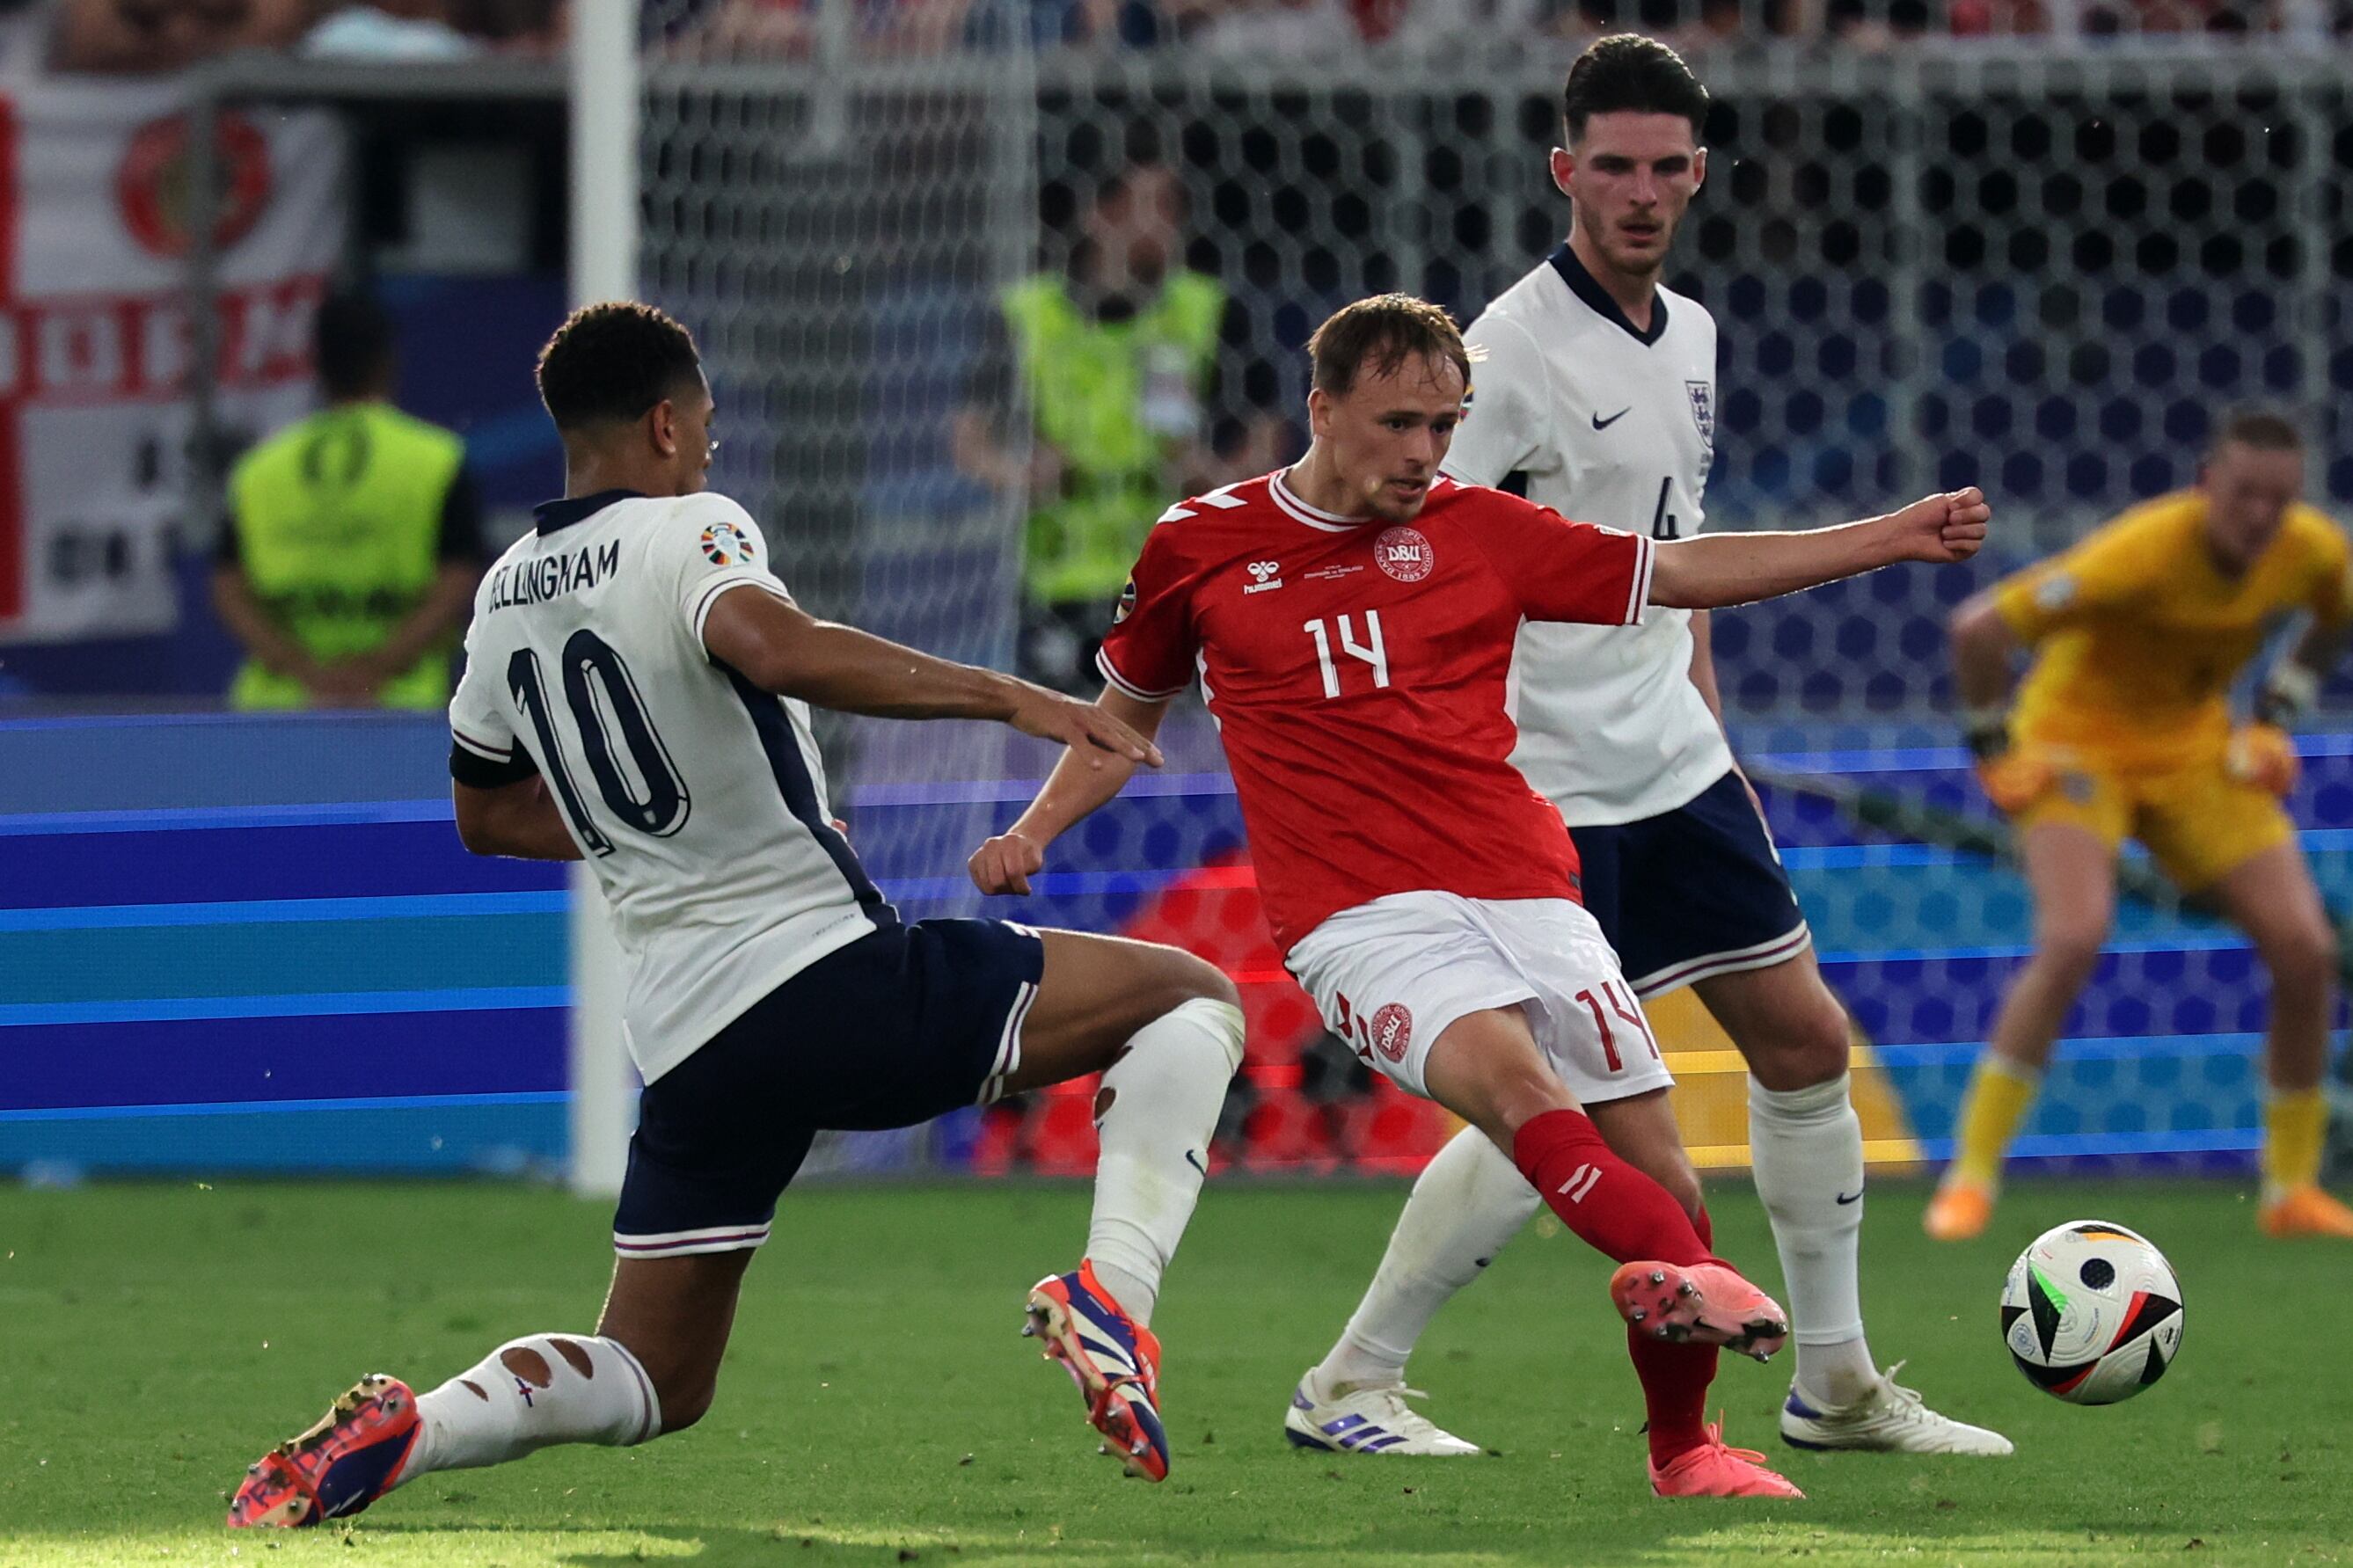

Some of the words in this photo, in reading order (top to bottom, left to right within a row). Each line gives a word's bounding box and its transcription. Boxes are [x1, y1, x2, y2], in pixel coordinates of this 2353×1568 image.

[1652, 476, 1680, 541] 4
[1387, 544, 1421, 562] DBU
[1304, 609, 1390, 699] 14
[508, 629, 691, 857] 10
[1381, 1014, 1402, 1051] DBU
[1575, 979, 1659, 1072] 14
